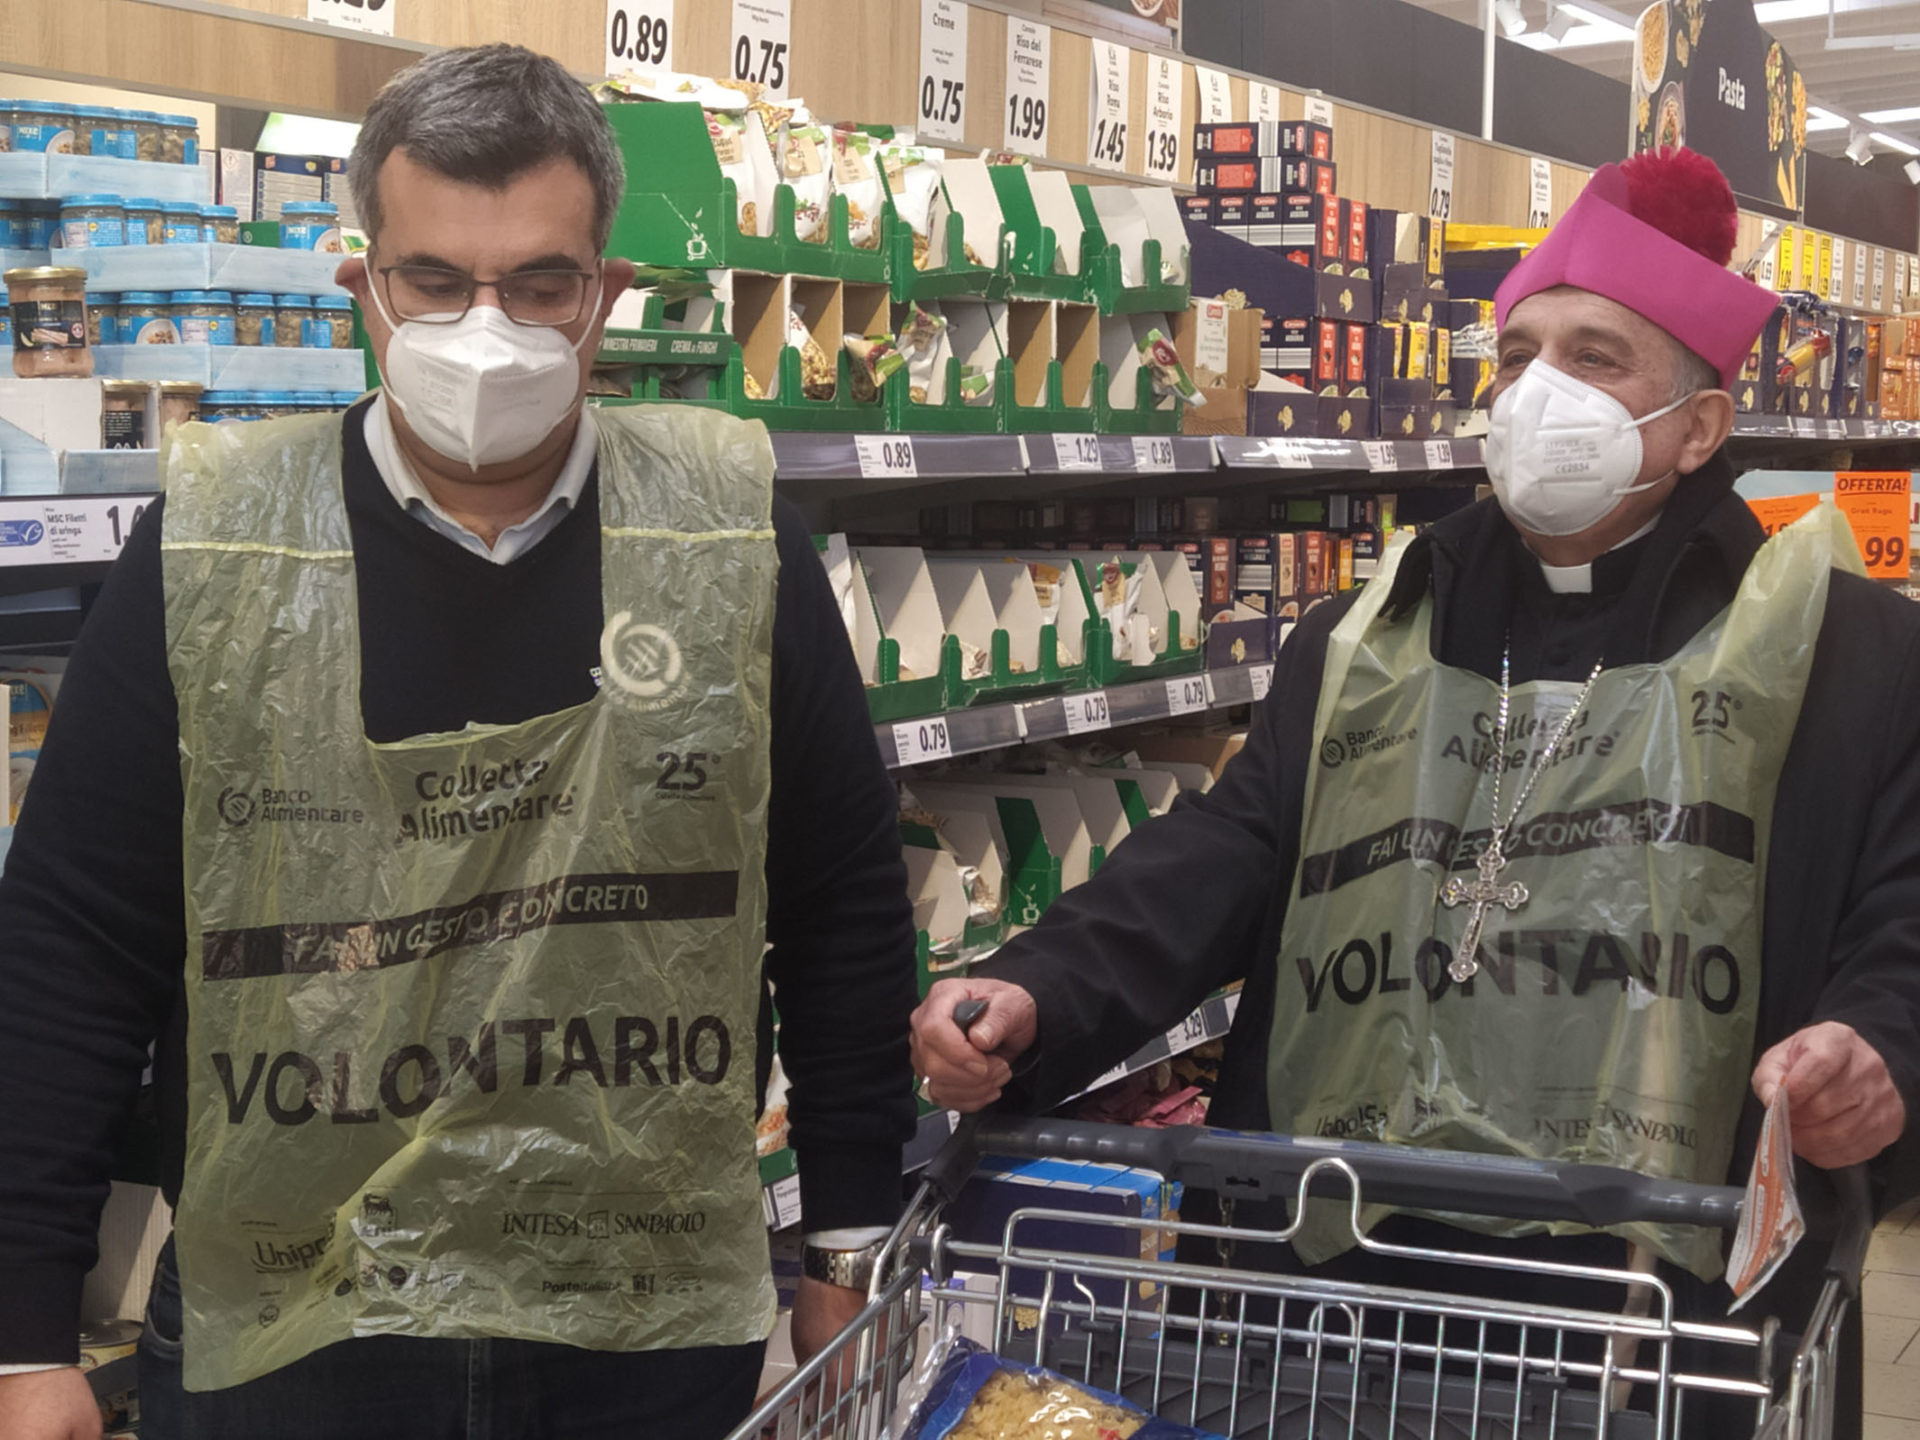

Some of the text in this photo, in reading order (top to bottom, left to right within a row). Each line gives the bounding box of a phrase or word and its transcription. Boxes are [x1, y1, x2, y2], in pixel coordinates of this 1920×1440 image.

[611, 9, 668, 64] 0.89
[735, 35, 787, 90] 0.75
[922, 75, 964, 124] 0.75
[1718, 66, 1746, 111] Pasta
[1009, 93, 1046, 140] 1.99
[1094, 118, 1127, 162] 1.45
[1148, 130, 1178, 172] 1.39
[1431, 187, 1451, 219] 0.79
[882, 441, 912, 468] 0.89
[1075, 437, 1099, 463] 1.29
[1837, 477, 1908, 492] OFFERTA!
[1085, 696, 1107, 722] 0.79
[1184, 680, 1204, 704] 0.79
[919, 723, 946, 751] 0.79
[262, 788, 312, 804] Banco
[395, 793, 573, 844] Alimentare
[1366, 831, 1397, 865] FAI
[1401, 826, 1445, 853] UN
[405, 905, 490, 952] GESTO
[498, 883, 648, 929] CONCRETO
[210, 1014, 731, 1126] VOLONTARIO
[502, 1211, 706, 1236] INTESA SANPAOLO
